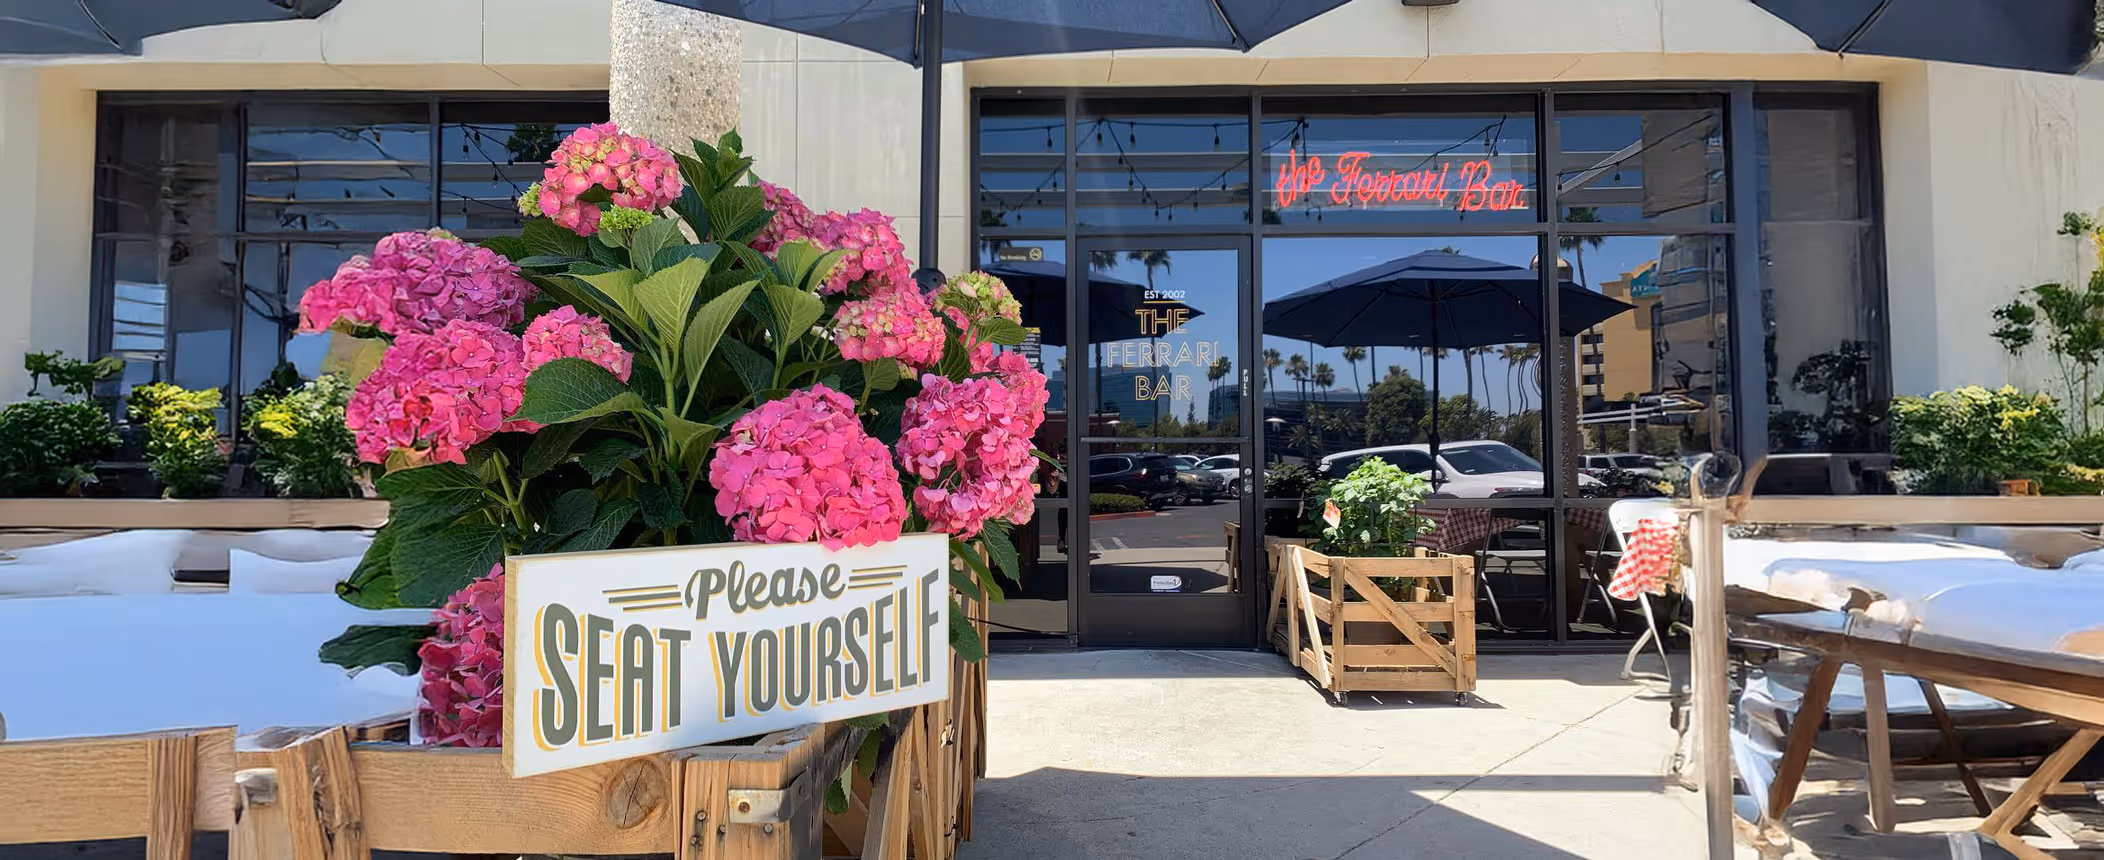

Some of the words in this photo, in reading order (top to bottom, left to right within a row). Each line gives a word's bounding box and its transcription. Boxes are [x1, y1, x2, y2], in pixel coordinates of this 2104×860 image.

[1276, 149, 1325, 208] the
[1331, 151, 1449, 204] Ferrari
[1459, 160, 1525, 211] Bar
[1144, 290, 1160, 299] EST
[1162, 290, 1186, 299] 2002
[1135, 308, 1190, 335] THE
[1106, 341, 1220, 368] FERRARI
[1135, 375, 1193, 401] BAR
[684, 559, 847, 622] Please
[533, 602, 692, 752] SEAT
[708, 567, 940, 722] YOURSELF
